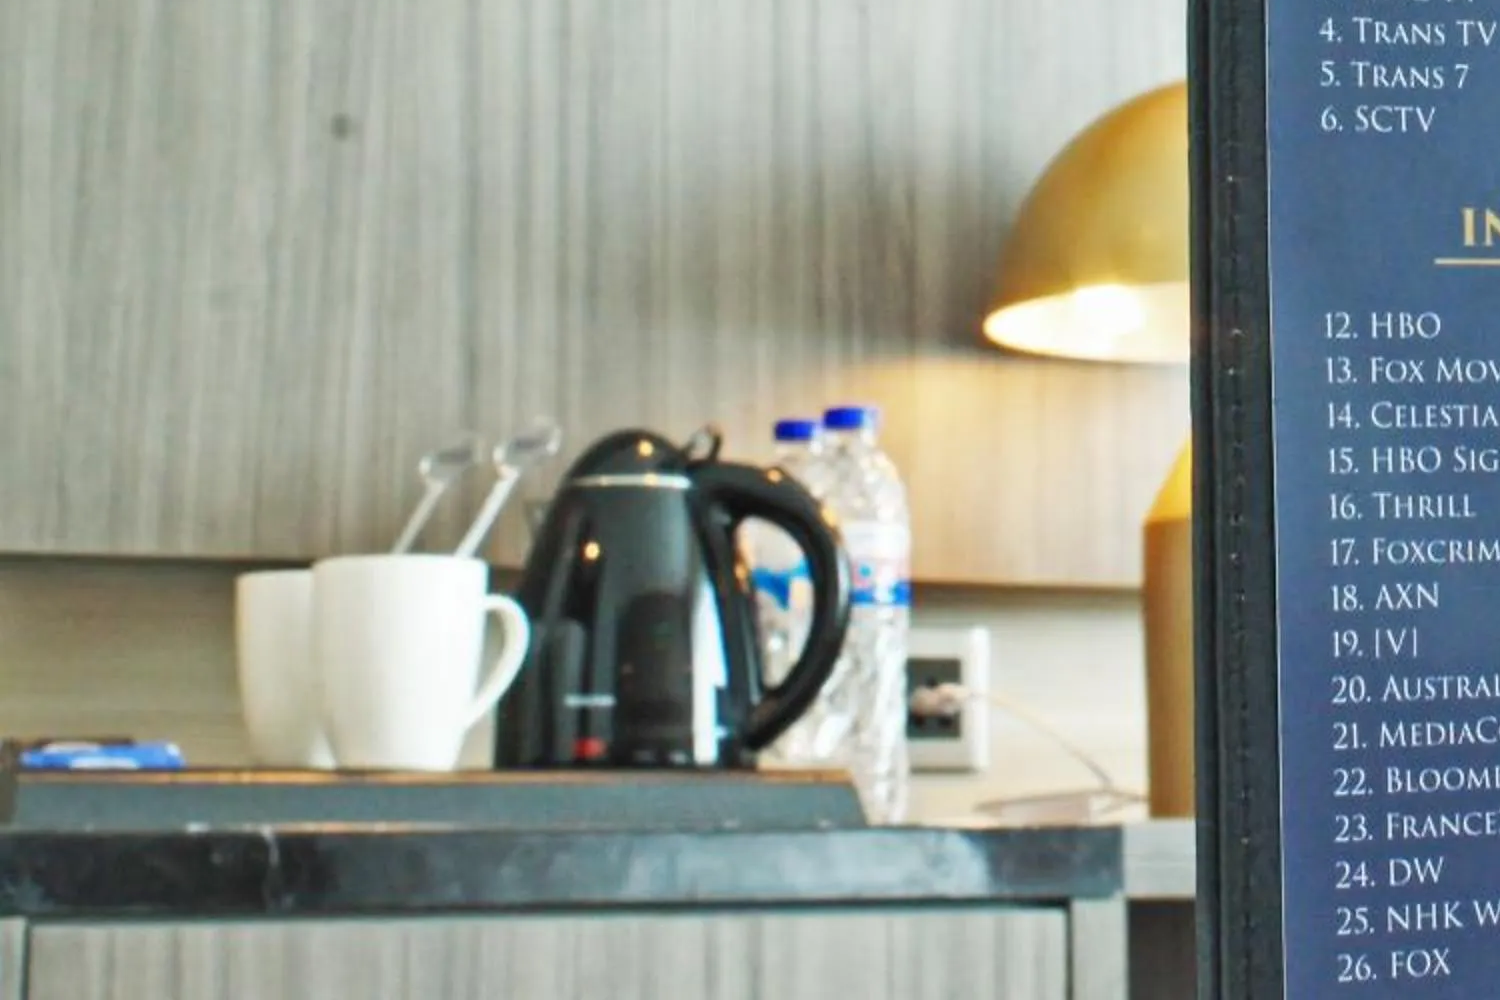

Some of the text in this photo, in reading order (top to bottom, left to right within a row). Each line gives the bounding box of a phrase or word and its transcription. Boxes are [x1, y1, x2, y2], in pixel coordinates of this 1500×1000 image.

[1319, 16, 1498, 47] 4. TRANS TV
[1320, 60, 1469, 90] 5. TRANS 7
[1320, 104, 1435, 133] 6. SCTV
[1324, 312, 1441, 339] 12. HBO
[1326, 357, 1358, 384] 13.
[1370, 356, 1425, 384] FOX
[1328, 402, 1360, 429] 14.
[1328, 448, 1359, 474] 15.
[1371, 447, 1442, 473] HBO
[1330, 492, 1477, 520] 16. THRILL
[1330, 539, 1360, 565] 17.
[1331, 582, 1440, 612] 18. AXN
[1333, 629, 1363, 658] 19.
[1330, 676, 1371, 704] 20.
[1332, 723, 1367, 750] 21.
[1332, 768, 1373, 796] 22.
[1333, 815, 1373, 842] 23.
[1335, 857, 1444, 889] 24. DW
[1335, 907, 1375, 936] 25.
[1386, 901, 1463, 933] NHK
[1337, 948, 1452, 983] 26. FOX
